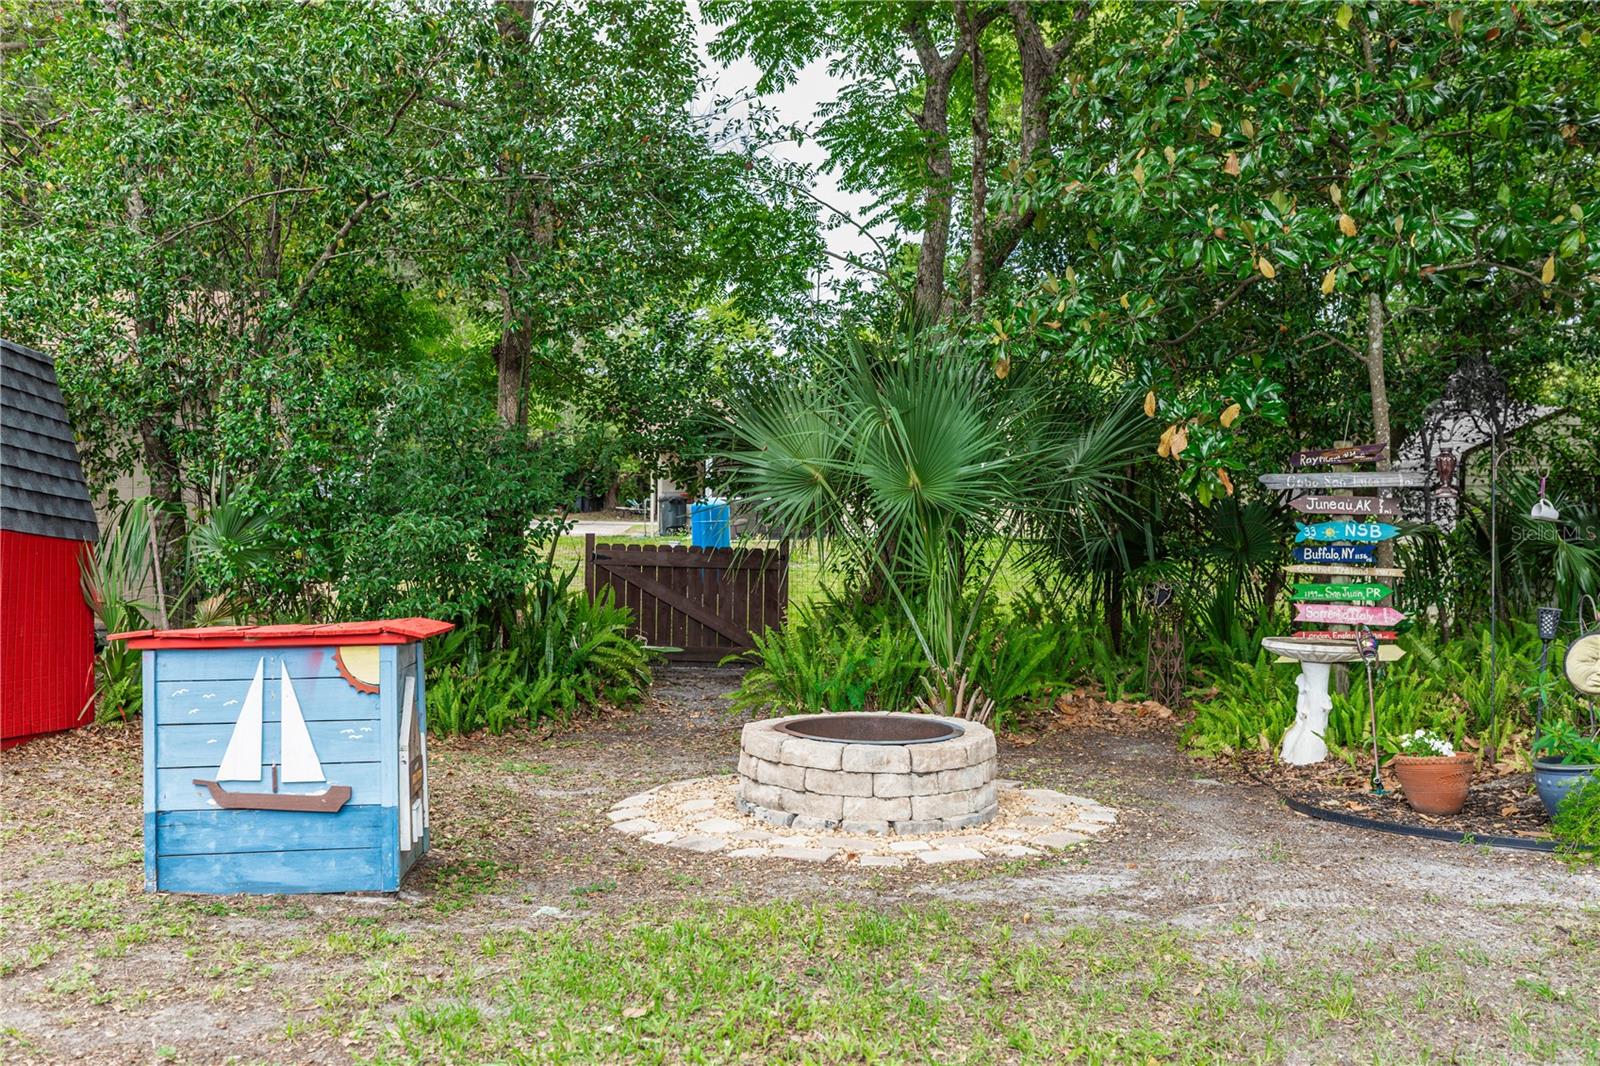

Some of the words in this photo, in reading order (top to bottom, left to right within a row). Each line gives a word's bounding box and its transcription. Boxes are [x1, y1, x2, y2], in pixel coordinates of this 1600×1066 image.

[1324, 475, 1346, 487] San
[1303, 526, 1317, 537] 33
[1345, 524, 1382, 538] NSB
[1325, 586, 1341, 598] San
[1366, 587, 1381, 598] PR
